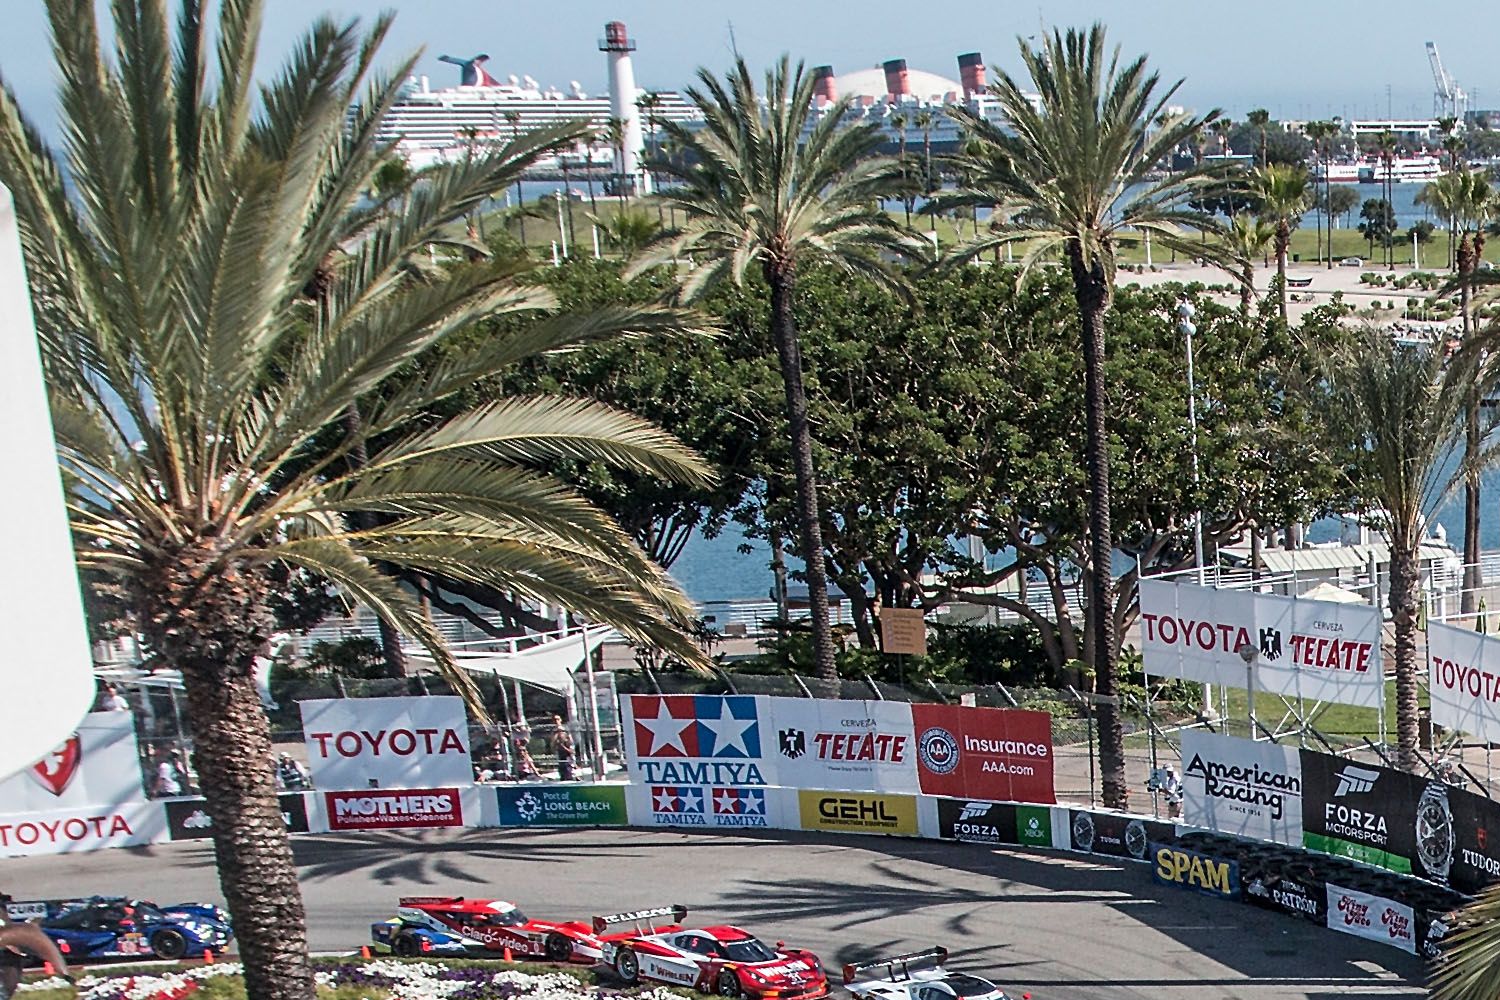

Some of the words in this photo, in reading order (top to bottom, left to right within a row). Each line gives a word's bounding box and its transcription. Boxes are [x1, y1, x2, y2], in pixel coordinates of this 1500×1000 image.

[1142, 613, 1251, 654] TOYOTA
[1313, 620, 1344, 632] CERVEZA
[1289, 634, 1373, 673] TECATE
[841, 719, 877, 728] CERVEZA
[311, 728, 466, 758] TOYOTA
[814, 732, 907, 762] TECATE
[930, 743, 949, 756] AAA
[964, 735, 1048, 757] Insurance
[638, 761, 768, 785] TAMIYA
[982, 761, 1034, 776] AAA.com
[1186, 752, 1300, 792] American
[334, 794, 453, 816] MOTHERS
[543, 792, 560, 800] Port
[544, 802, 573, 811] LONG
[576, 802, 610, 811] BEACH
[1204, 774, 1283, 820] Racing
[653, 813, 706, 825] TAMIYA
[713, 815, 768, 827] TAMIYA
[818, 797, 898, 821] GEHL
[1325, 802, 1388, 834] FORZA
[0, 815, 133, 847] TOYOTA
[953, 823, 1000, 836] FORZA
[1025, 828, 1045, 838] XBOX
[1100, 836, 1121, 845] TUDOR
[1325, 821, 1388, 846] MOTORSPORT
[1156, 848, 1231, 894] SPAM
[1462, 848, 1500, 876] TUDOR
[1273, 889, 1317, 915] PATRÓN
[461, 926, 493, 943] Claro
[498, 935, 529, 953] video
[656, 966, 694, 984] WHELEN
